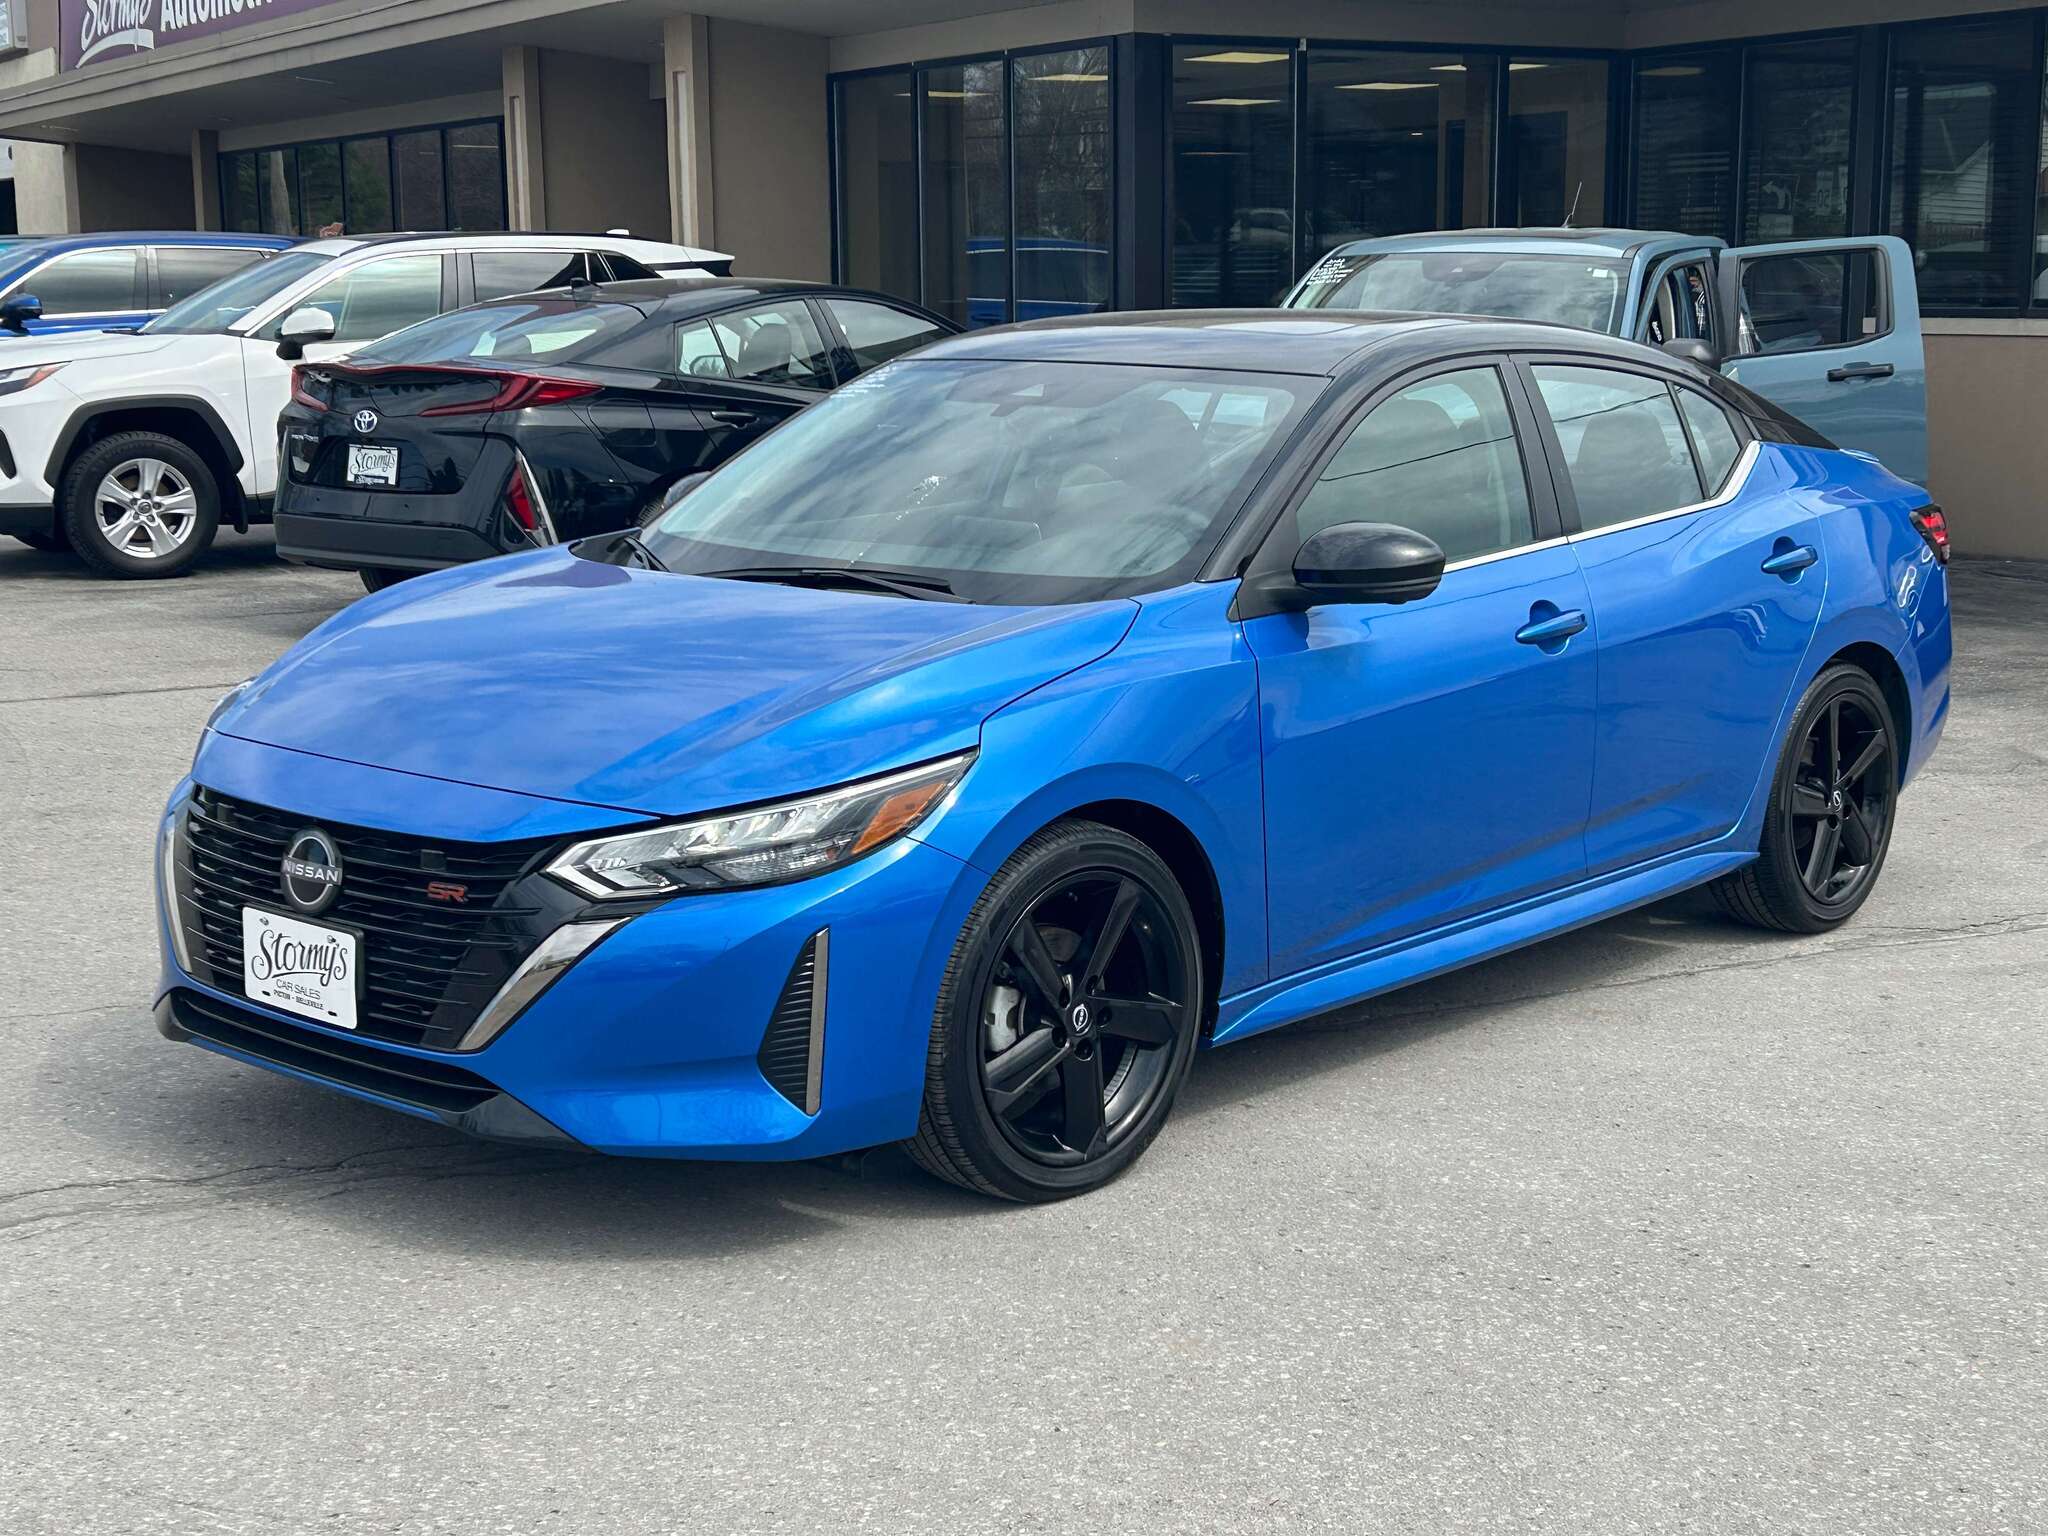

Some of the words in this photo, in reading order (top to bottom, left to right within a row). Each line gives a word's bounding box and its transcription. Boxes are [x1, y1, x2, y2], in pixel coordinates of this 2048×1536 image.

[283, 859, 338, 882] NISSAN
[428, 881, 468, 902] SR
[252, 929, 348, 987] Stormy's
[276, 979, 294, 992] CAR
[294, 984, 321, 1000] SALES
